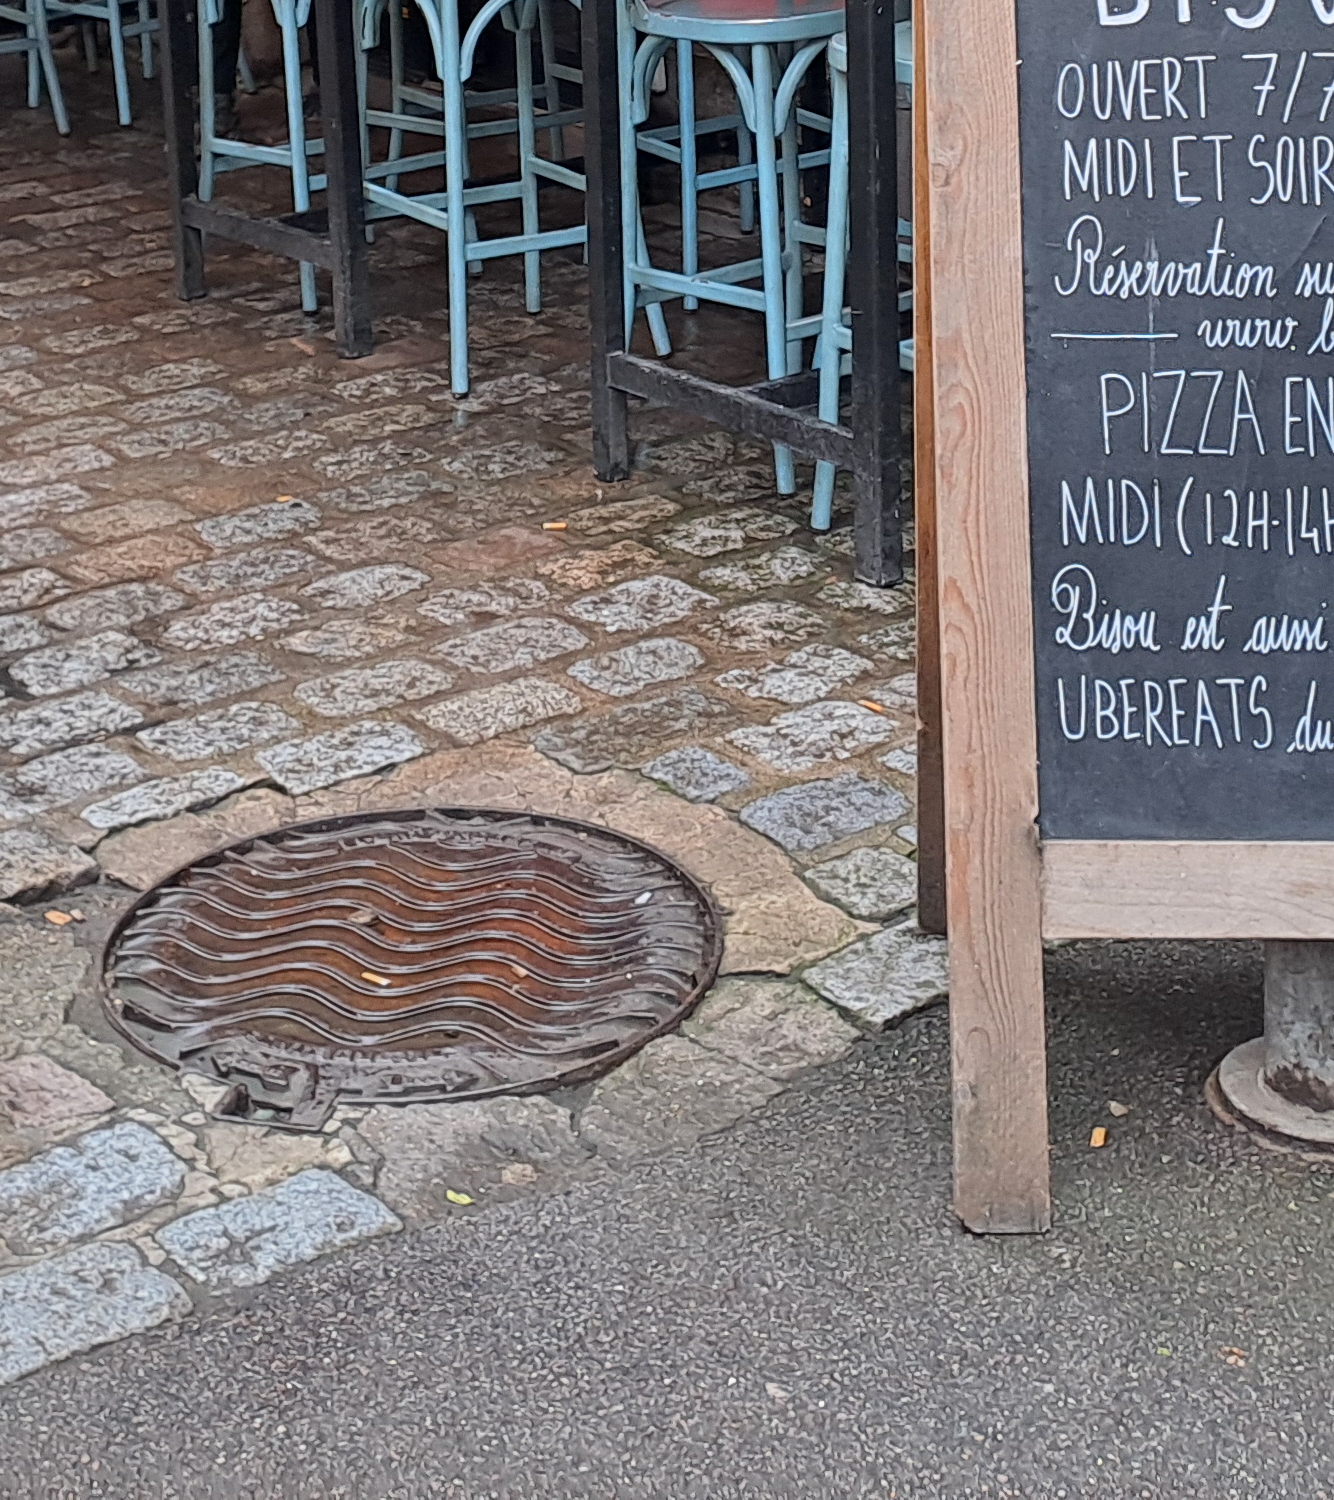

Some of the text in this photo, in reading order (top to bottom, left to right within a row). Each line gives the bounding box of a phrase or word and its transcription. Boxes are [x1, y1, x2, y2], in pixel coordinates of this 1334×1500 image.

[1056, 55, 1217, 121] OUVERT
[1063, 137, 1154, 203] MIDI
[1172, 134, 1234, 206] ET
[1054, 214, 1278, 300] Réservation
[1100, 368, 1266, 457] PIZZA
[1051, 563, 1162, 654] Bisou
[1180, 573, 1234, 652] est
[1242, 601, 1330, 655] aussi
[1057, 673, 1274, 750] UBEREATS
